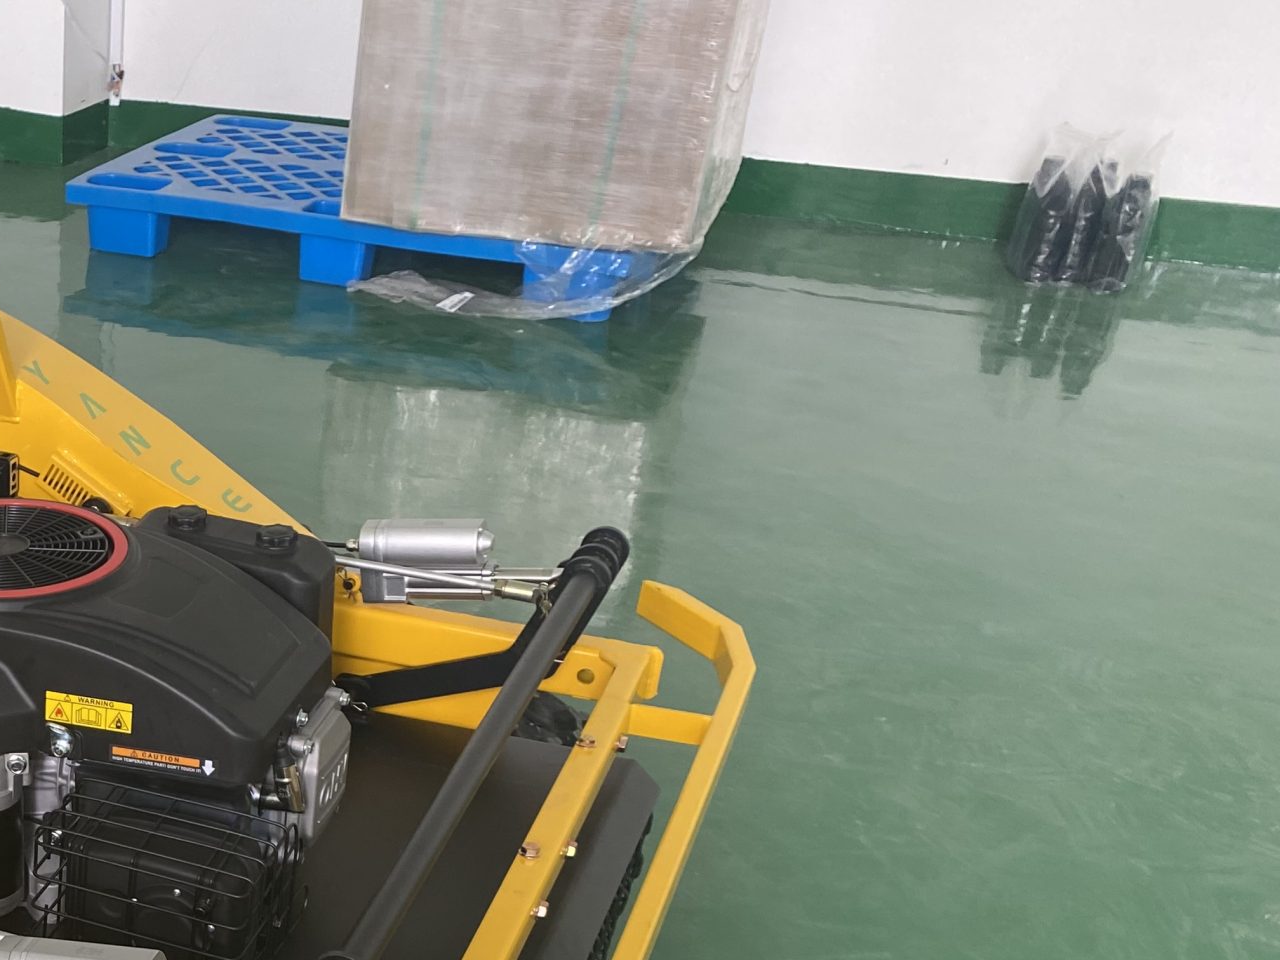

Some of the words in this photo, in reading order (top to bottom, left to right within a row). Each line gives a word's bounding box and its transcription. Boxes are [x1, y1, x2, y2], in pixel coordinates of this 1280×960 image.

[77, 696, 115, 708] WARNING
[124, 757, 154, 766] TEMPERATURE
[141, 752, 180, 763] CAUTION
